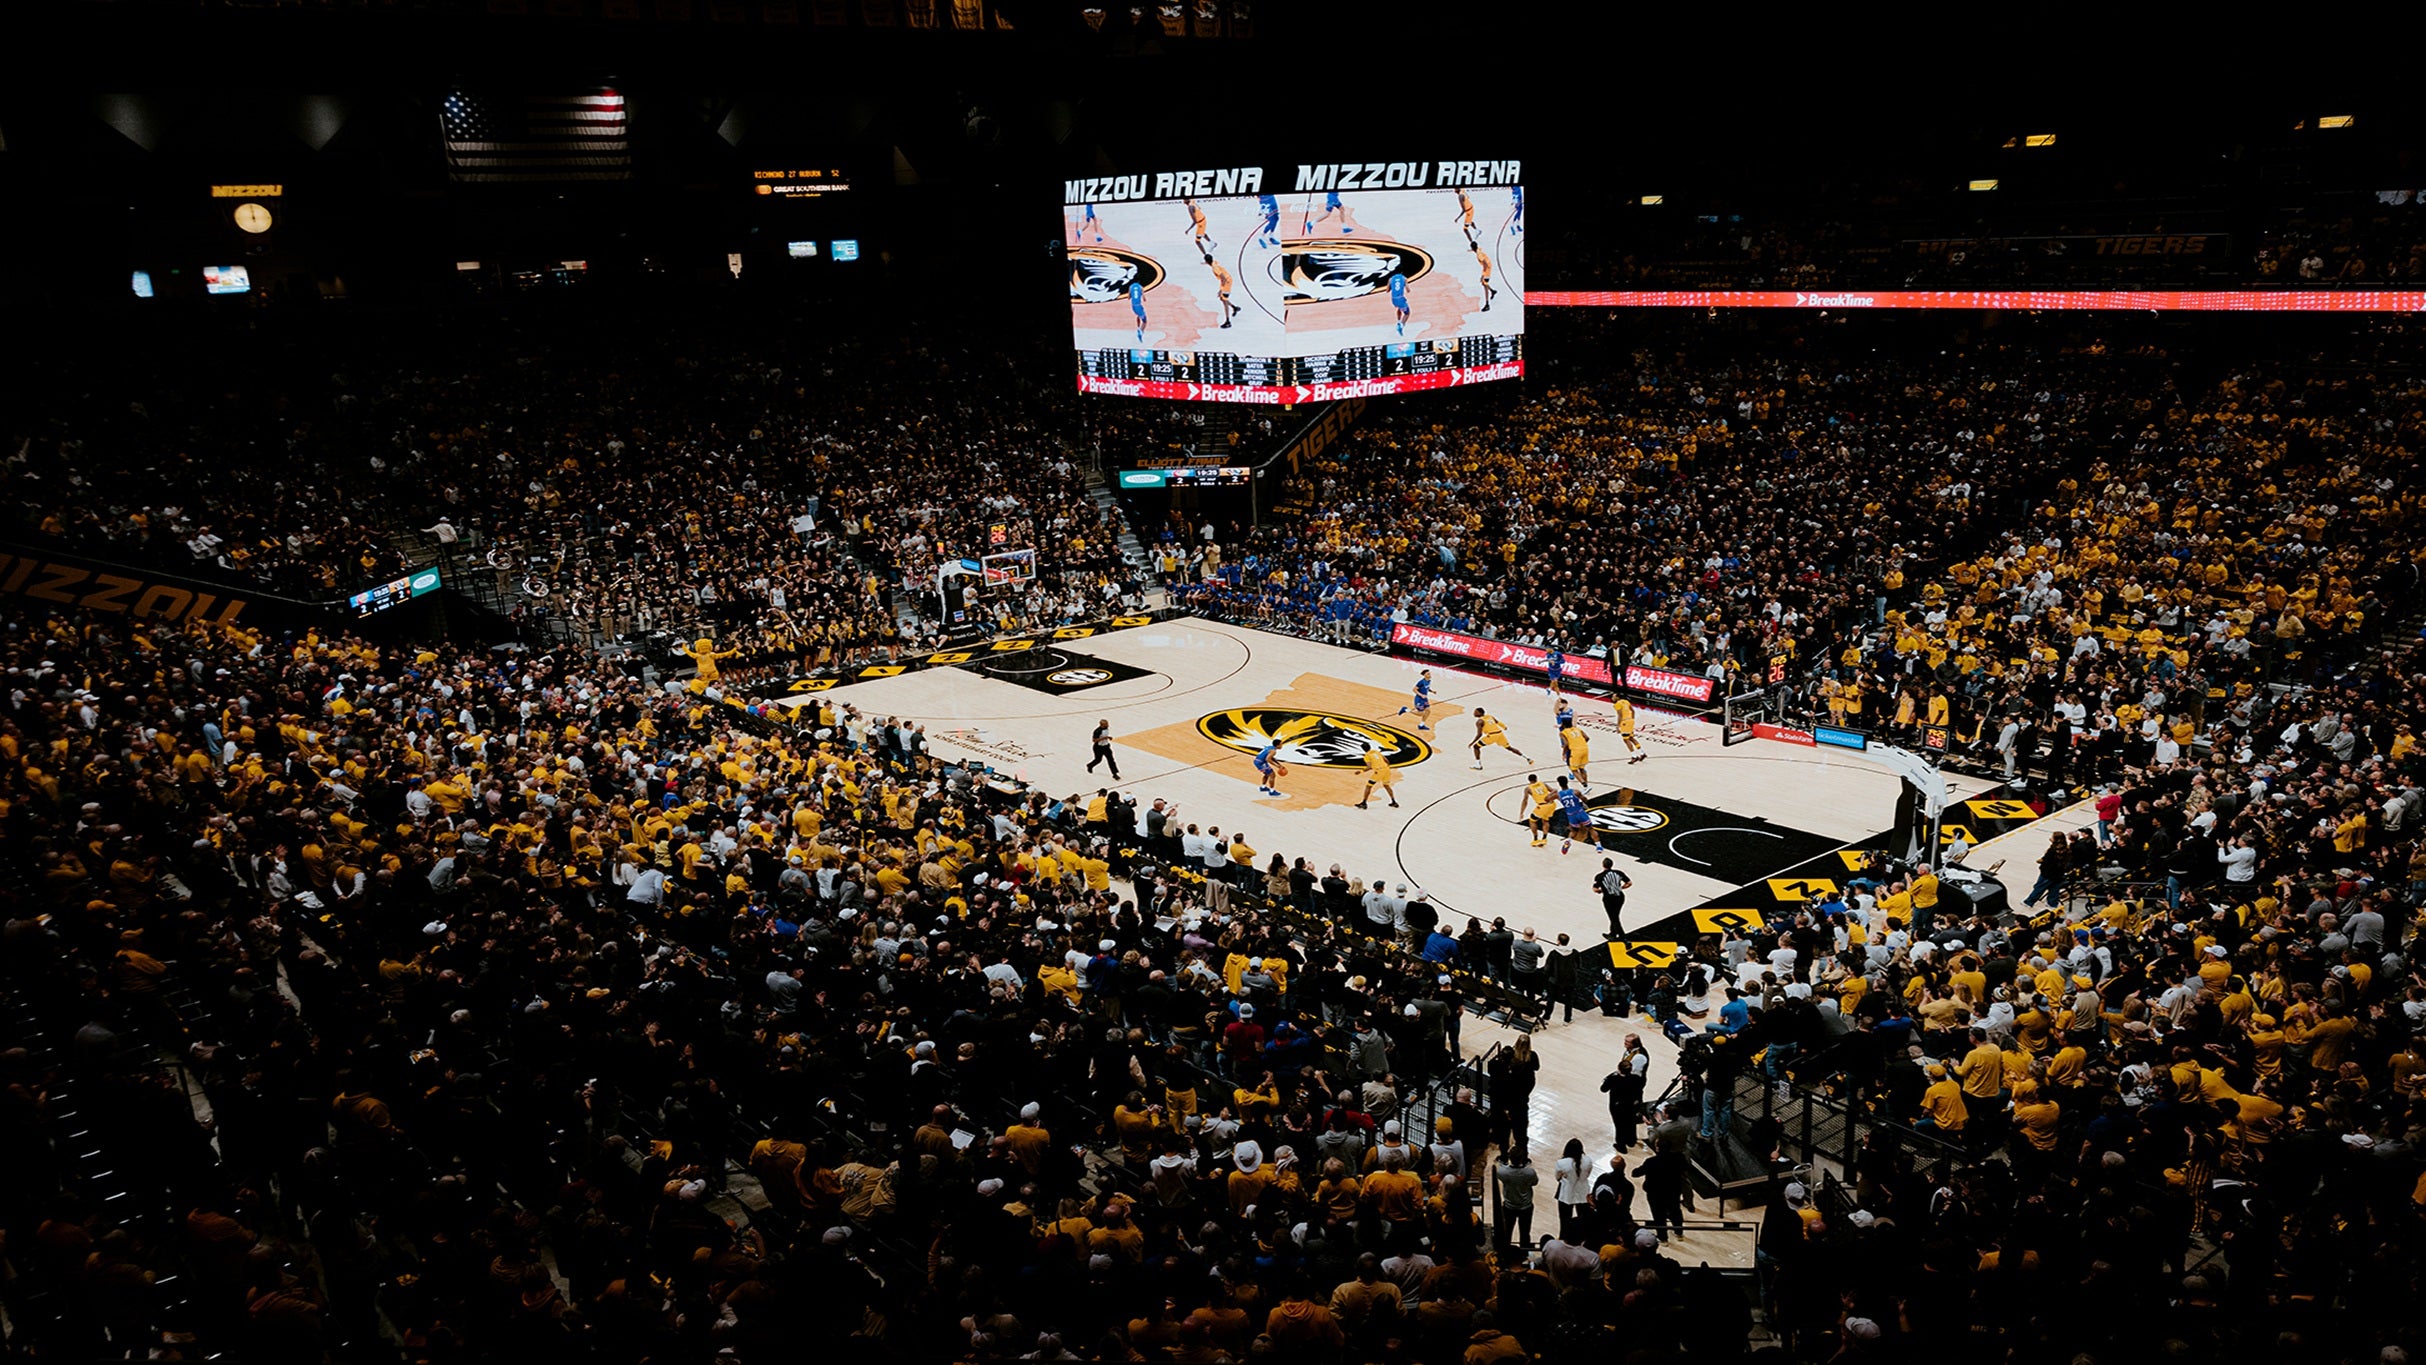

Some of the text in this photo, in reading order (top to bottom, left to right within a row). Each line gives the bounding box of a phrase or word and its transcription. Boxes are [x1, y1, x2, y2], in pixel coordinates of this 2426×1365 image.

[1065, 167, 1263, 204] MIZZOU ARENA
[1295, 160, 1521, 191] MIZZOU ARENA
[211, 184, 283, 197] MIZZOU
[2096, 236, 2208, 256] TIGERS
[1808, 293, 1874, 307] BreakTime
[1137, 364, 1145, 376] 2
[1152, 363, 1171, 374] 19:25
[1181, 367, 1189, 379] 2
[1396, 353, 1453, 371] 2 19:25 2
[1463, 363, 1519, 385] BreakTime
[1089, 376, 1139, 397] BreakTime
[1202, 383, 1279, 404] BreakTime
[1313, 379, 1396, 402] BreakTime
[1136, 456, 1231, 467] ELLIOTT FAMILY
[991, 531, 1006, 544] 26
[0, 553, 248, 628] IZZOU
[1409, 630, 1471, 653] BreakTime
[1512, 651, 1581, 674] Breakme
[1629, 670, 1705, 697] BreakTime
[1769, 664, 1785, 683] 26
[1928, 736, 1943, 748] 26
[1563, 799, 1576, 808] 24
